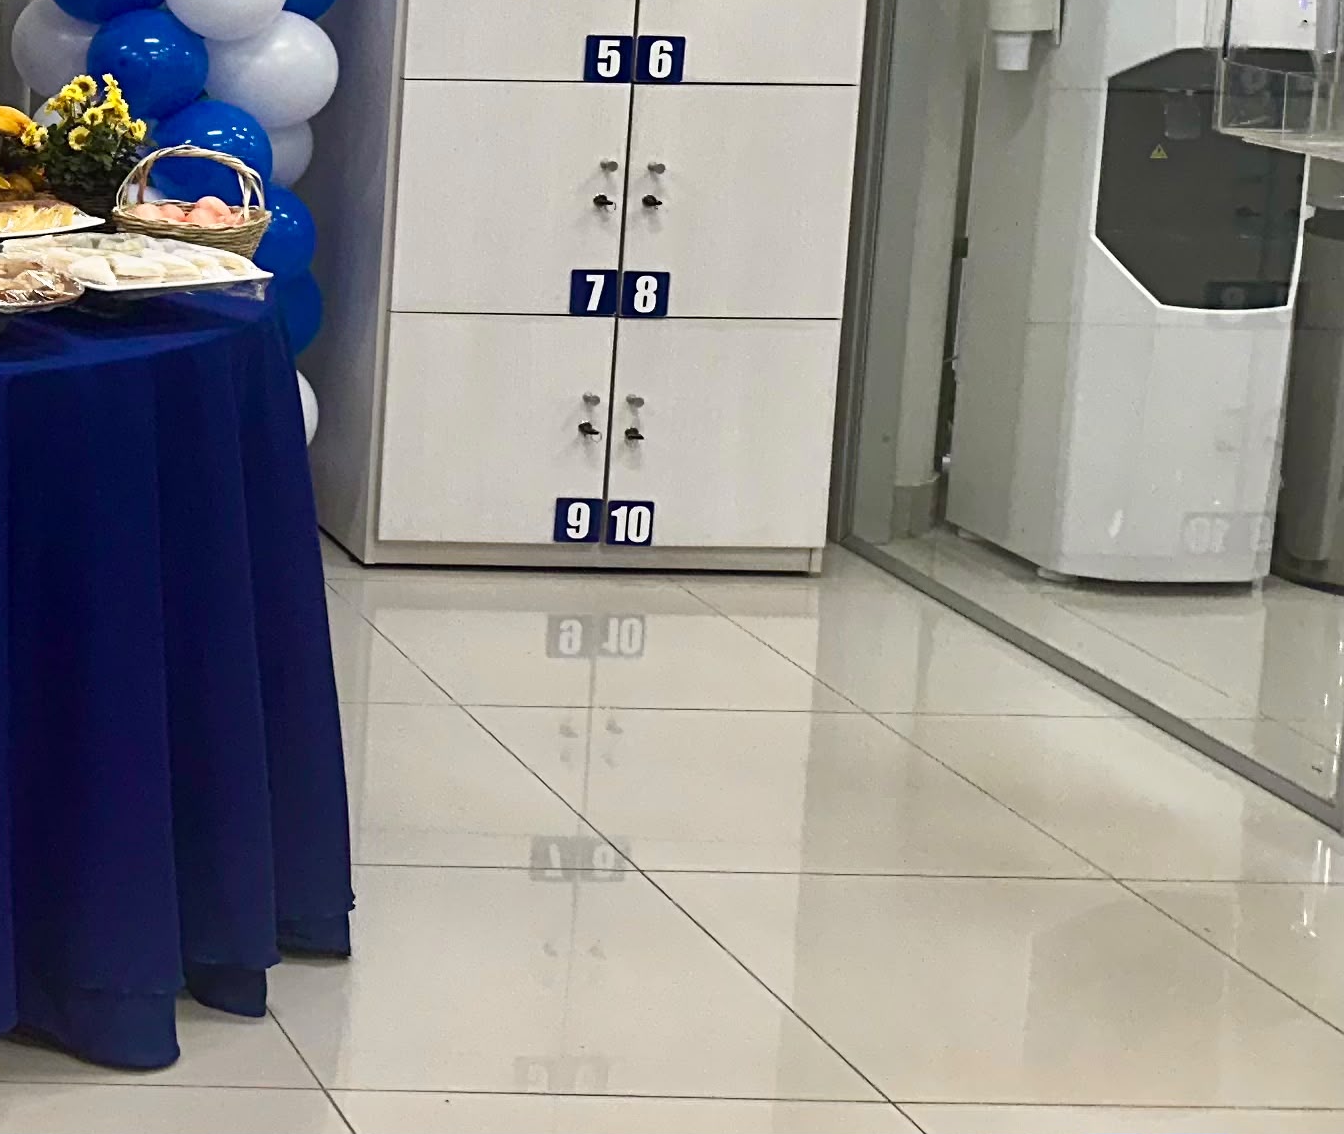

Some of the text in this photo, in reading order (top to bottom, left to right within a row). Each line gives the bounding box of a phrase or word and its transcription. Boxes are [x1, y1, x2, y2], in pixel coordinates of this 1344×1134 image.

[597, 39, 621, 78] 5
[648, 39, 674, 79] 6
[586, 274, 605, 311] 7
[633, 275, 658, 313] 8
[566, 502, 591, 539] 9
[610, 505, 651, 543] 10
